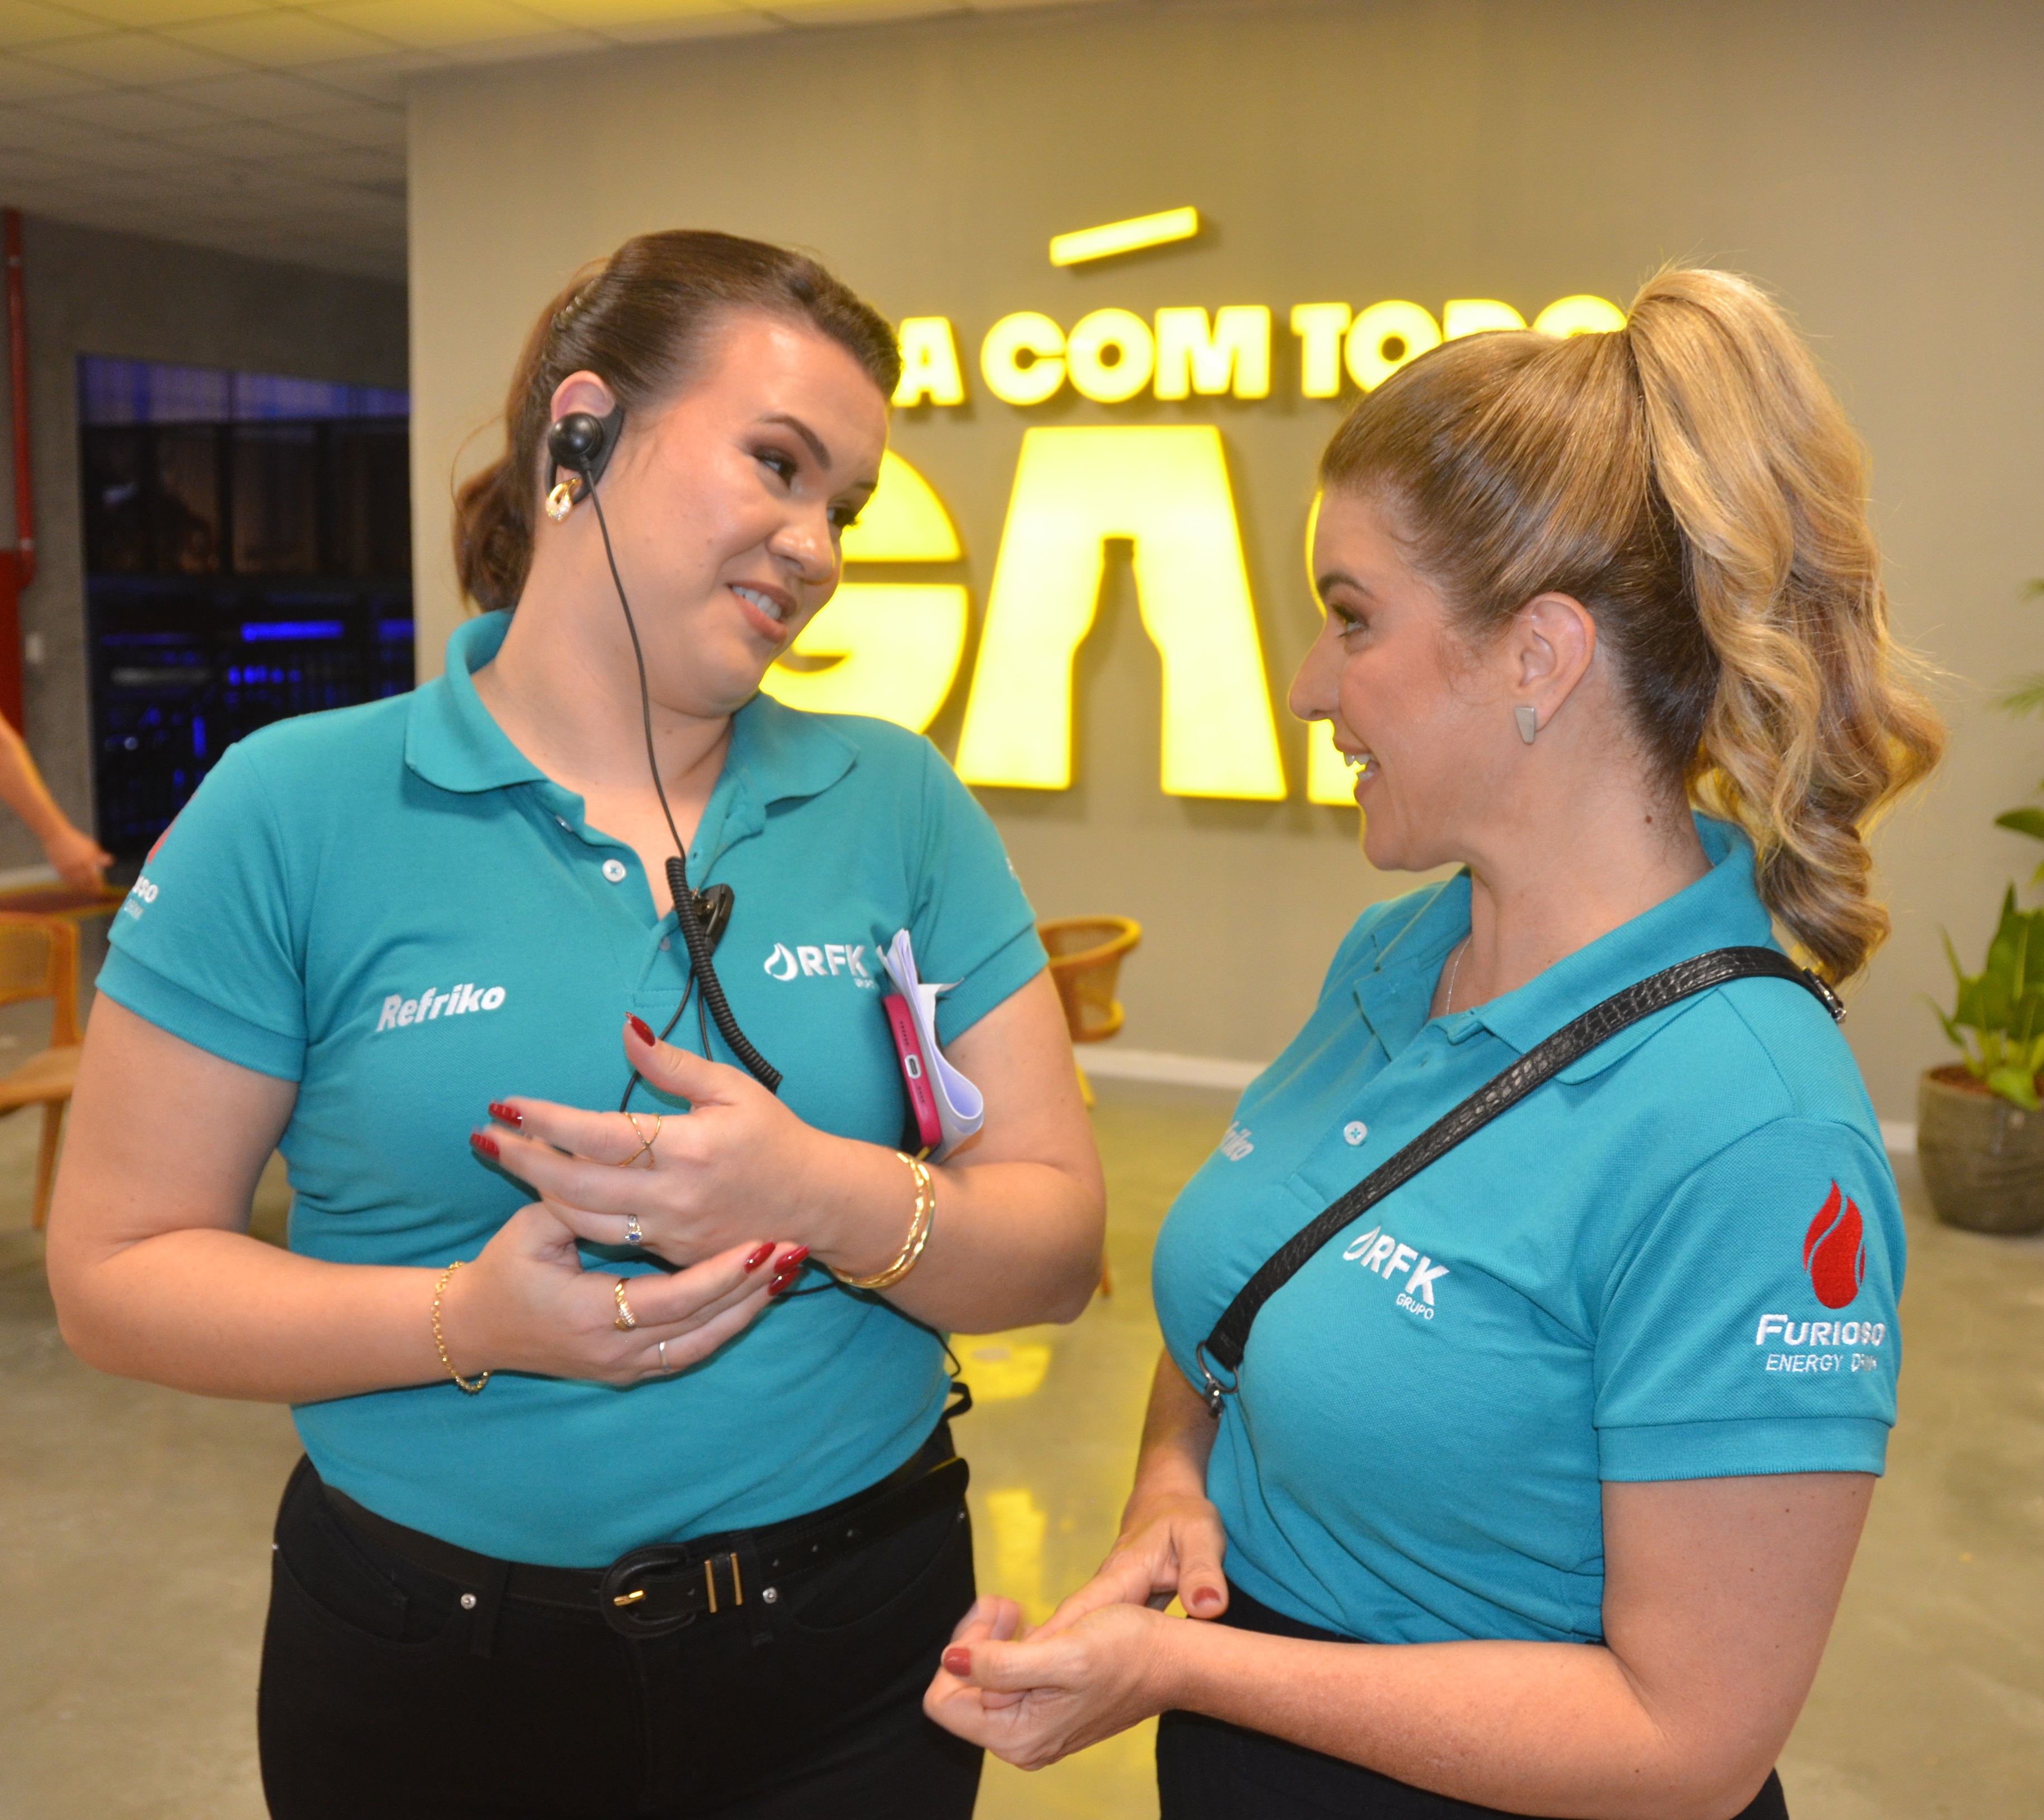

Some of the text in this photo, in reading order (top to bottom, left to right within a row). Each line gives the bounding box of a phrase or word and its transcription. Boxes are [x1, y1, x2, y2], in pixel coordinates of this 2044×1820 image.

[980, 306, 1272, 406] COM
[796, 944, 870, 978] RFK
[376, 983, 506, 1031] Refriko
[1360, 1234, 1449, 1306] RFK
[1396, 1293, 1434, 1320] GRUPO
[1756, 1314, 1886, 1346] FURIOSO
[1766, 1354, 1843, 1372] ENERGY
